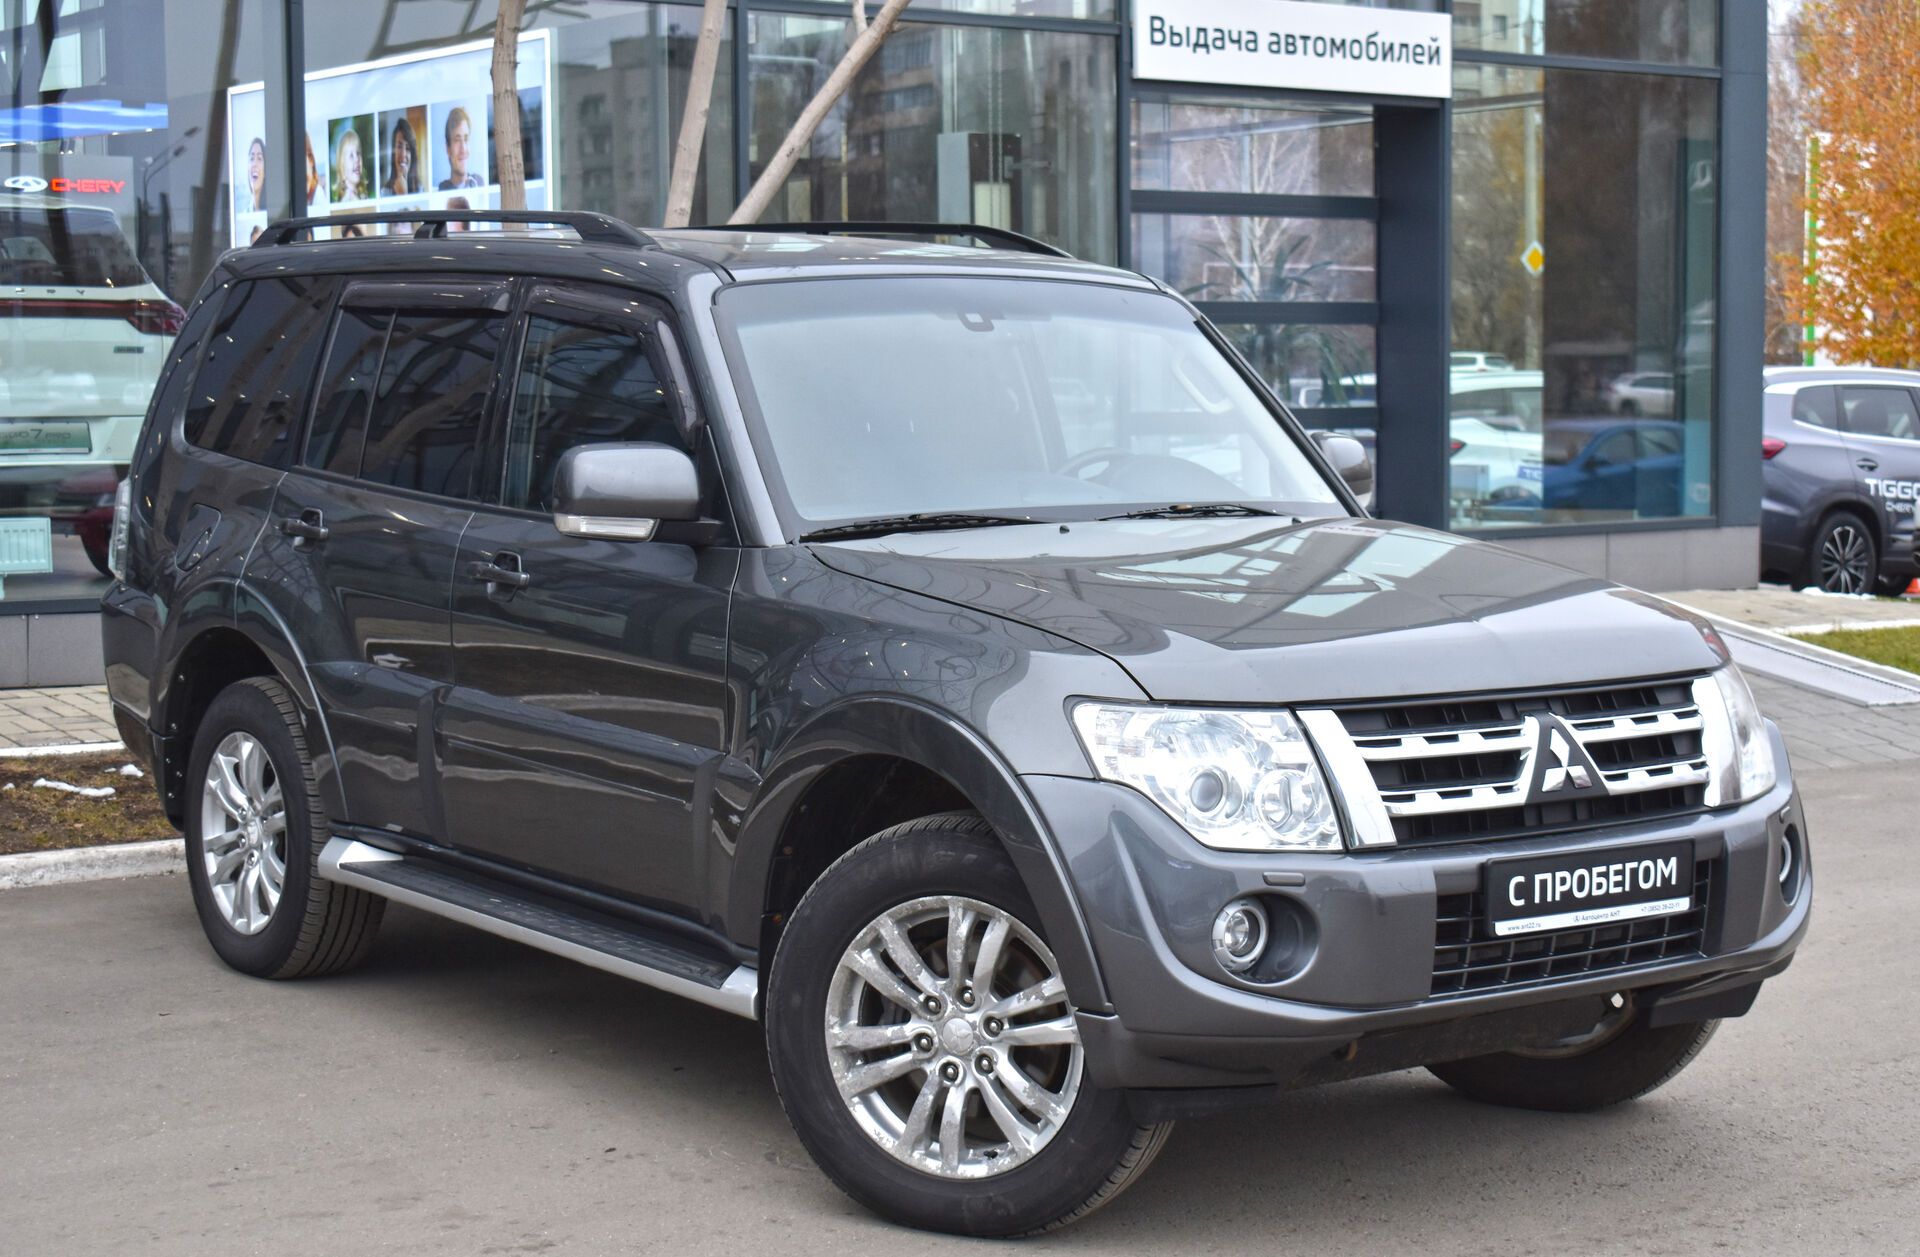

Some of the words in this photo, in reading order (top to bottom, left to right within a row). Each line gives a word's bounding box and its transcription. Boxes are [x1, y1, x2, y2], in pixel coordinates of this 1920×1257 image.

[1149, 15, 1259, 55] Выдача
[1267, 31, 1442, 65] автомобилей
[50, 178, 126, 194] CHERY
[30, 428, 43, 439] 7
[1508, 875, 1525, 906] С
[1534, 856, 1677, 903] ПРОБЕГОМ
